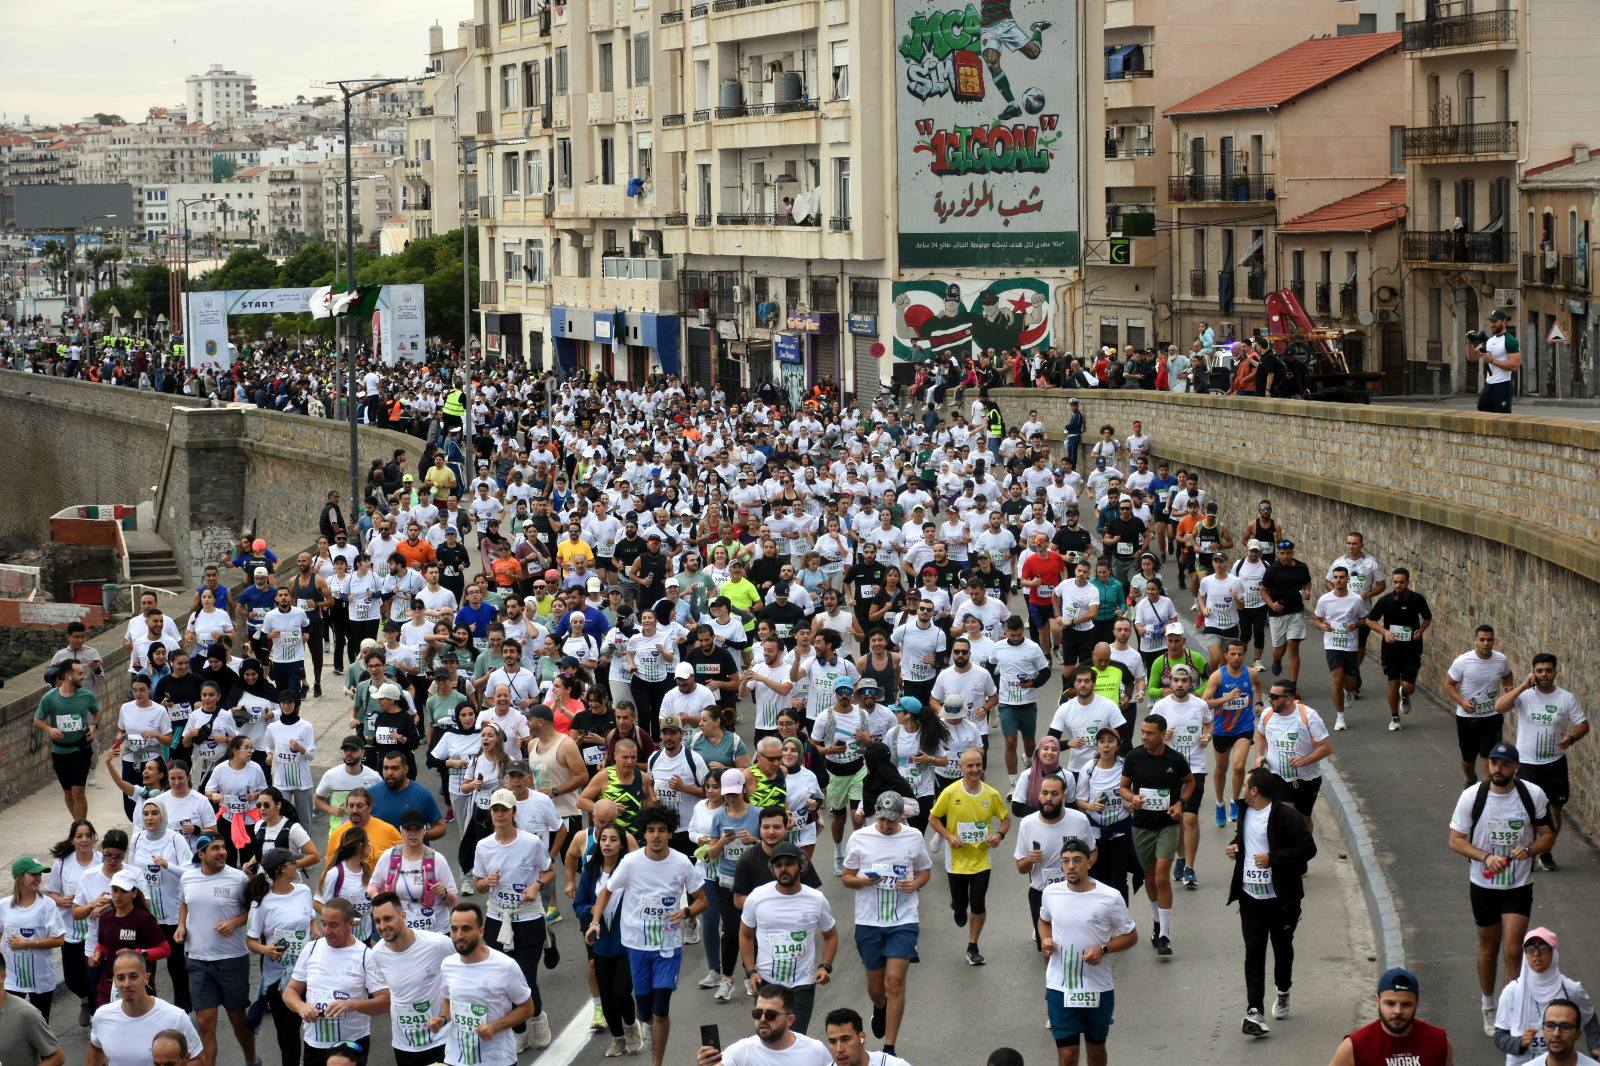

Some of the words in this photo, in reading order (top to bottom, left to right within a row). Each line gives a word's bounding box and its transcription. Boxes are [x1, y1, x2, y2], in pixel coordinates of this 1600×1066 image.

[934, 179, 994, 224] المولودية
[998, 186, 1043, 227] شعب
[241, 301, 274, 309] START
[1530, 712, 1552, 722] 5246
[62, 721, 76, 730] 367
[1275, 740, 1295, 748] 1837
[657, 789, 677, 798] 3102
[962, 831, 984, 840] 5299
[1491, 831, 1519, 840] 1395
[1246, 870, 1269, 879] 4576
[214, 887, 231, 896] RUN
[498, 891, 522, 902] 4531
[407, 919, 432, 929] 2654
[774, 943, 803, 954] 1144
[1070, 992, 1096, 1002] 2051
[399, 1014, 427, 1025] 5241
[454, 1014, 480, 1027] 5383
